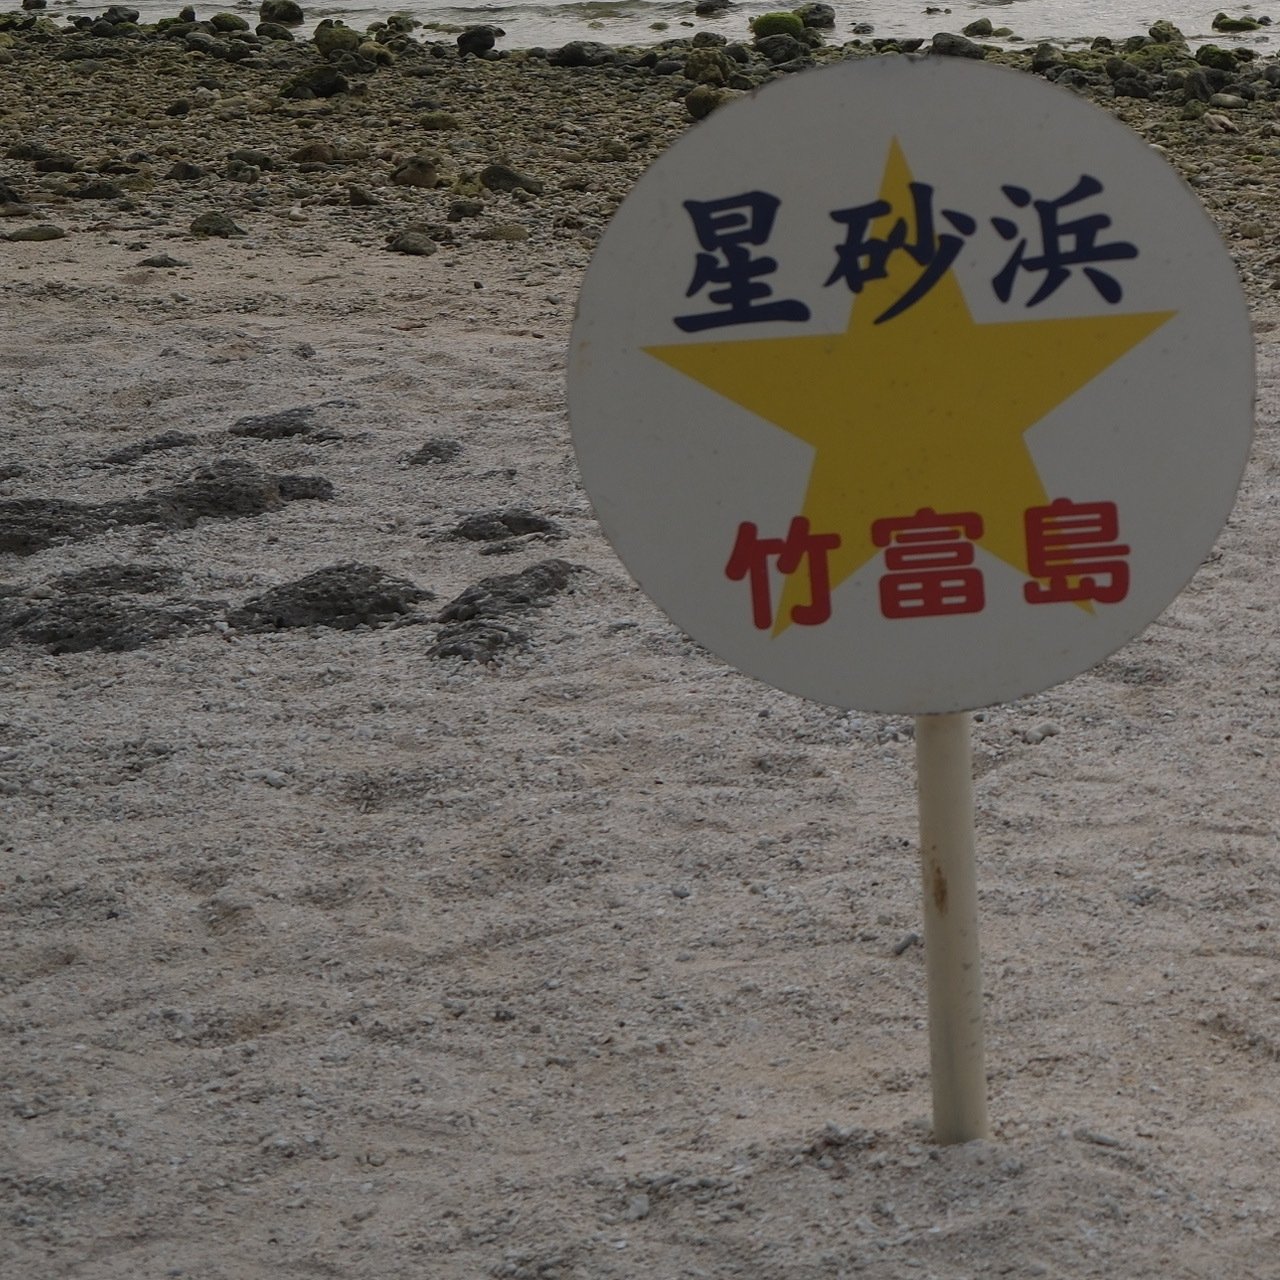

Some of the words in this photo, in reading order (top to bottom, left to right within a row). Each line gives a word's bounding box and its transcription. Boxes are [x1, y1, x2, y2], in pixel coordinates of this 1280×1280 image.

[671, 173, 1140, 334] 星砂浜
[723, 496, 1132, 631] 竹富島
